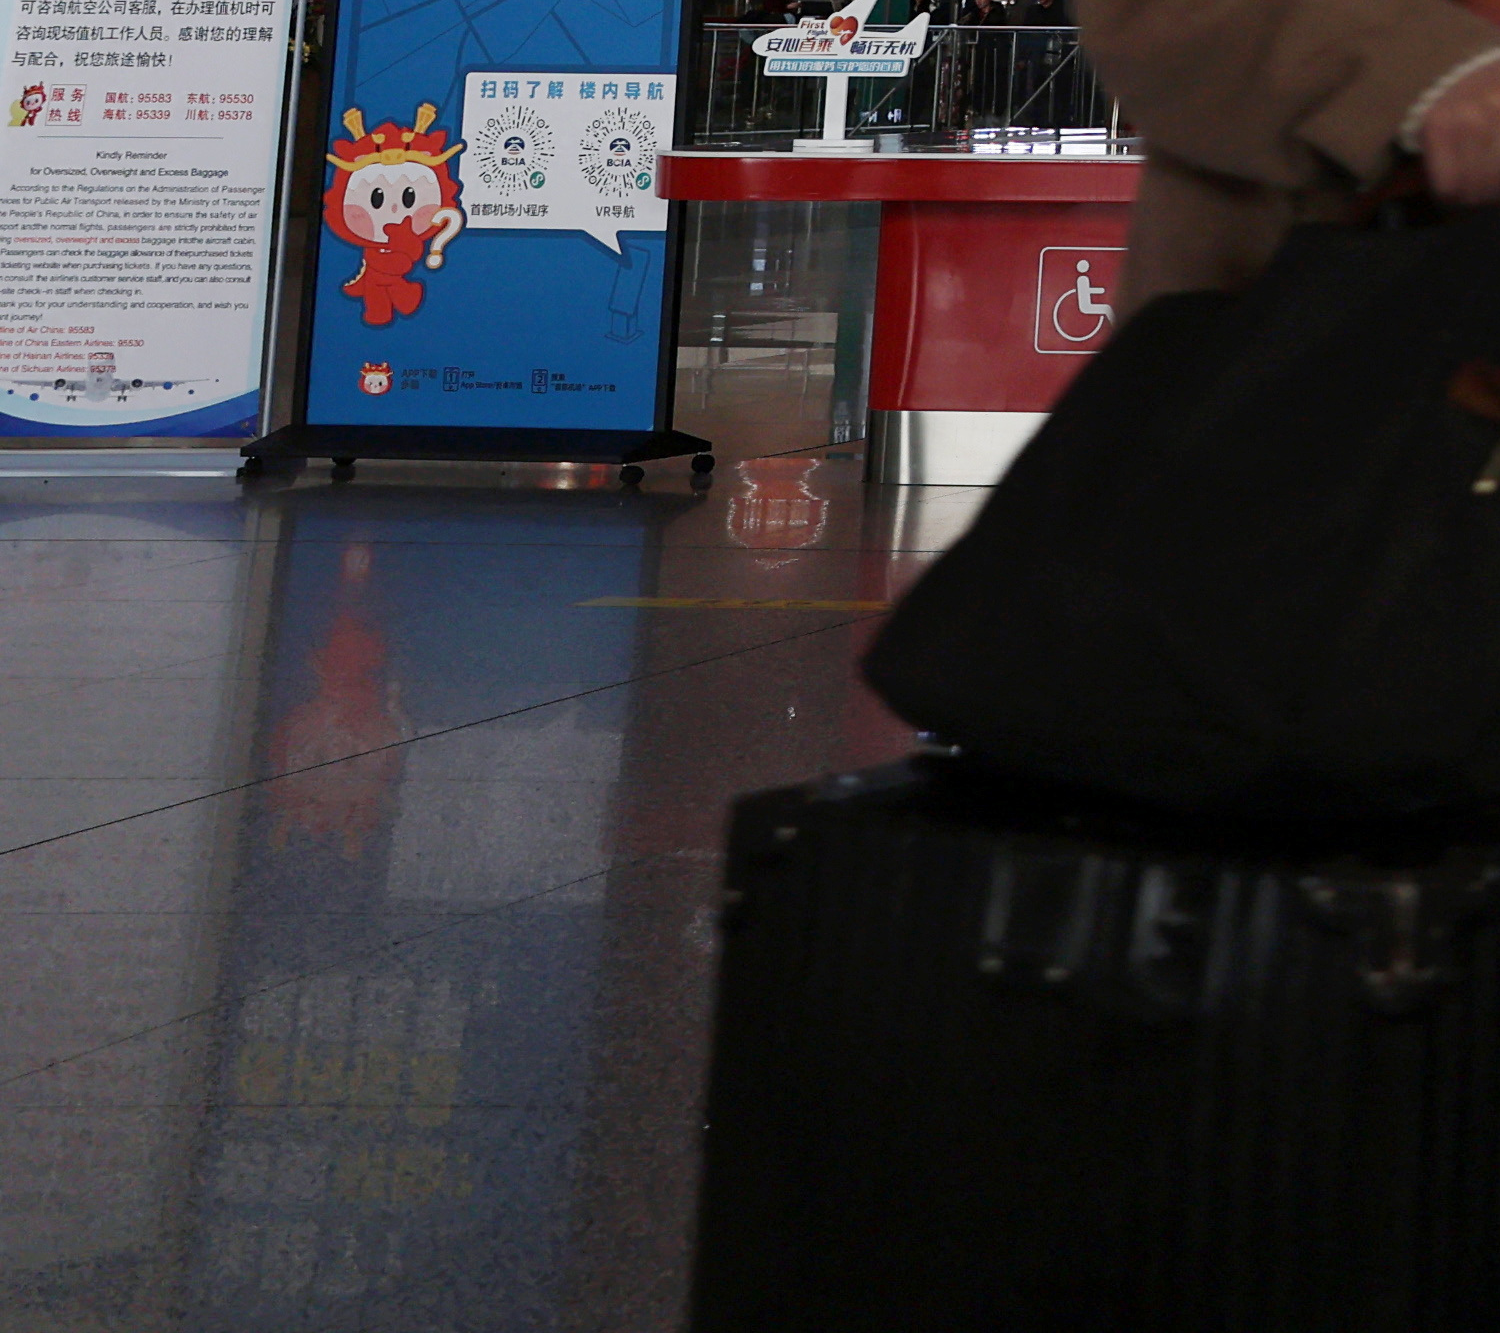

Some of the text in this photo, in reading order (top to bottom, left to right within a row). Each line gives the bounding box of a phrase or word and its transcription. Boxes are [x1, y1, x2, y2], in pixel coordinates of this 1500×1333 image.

[801, 21, 824, 29] First
[766, 37, 917, 55] 安心首乘 畅行无忧
[481, 80, 665, 100] 扫码了解 楼内导航
[96, 151, 167, 161] Kindly Reminder
[471, 204, 549, 217] 首都机场小程序
[595, 205, 634, 218] VR导航
